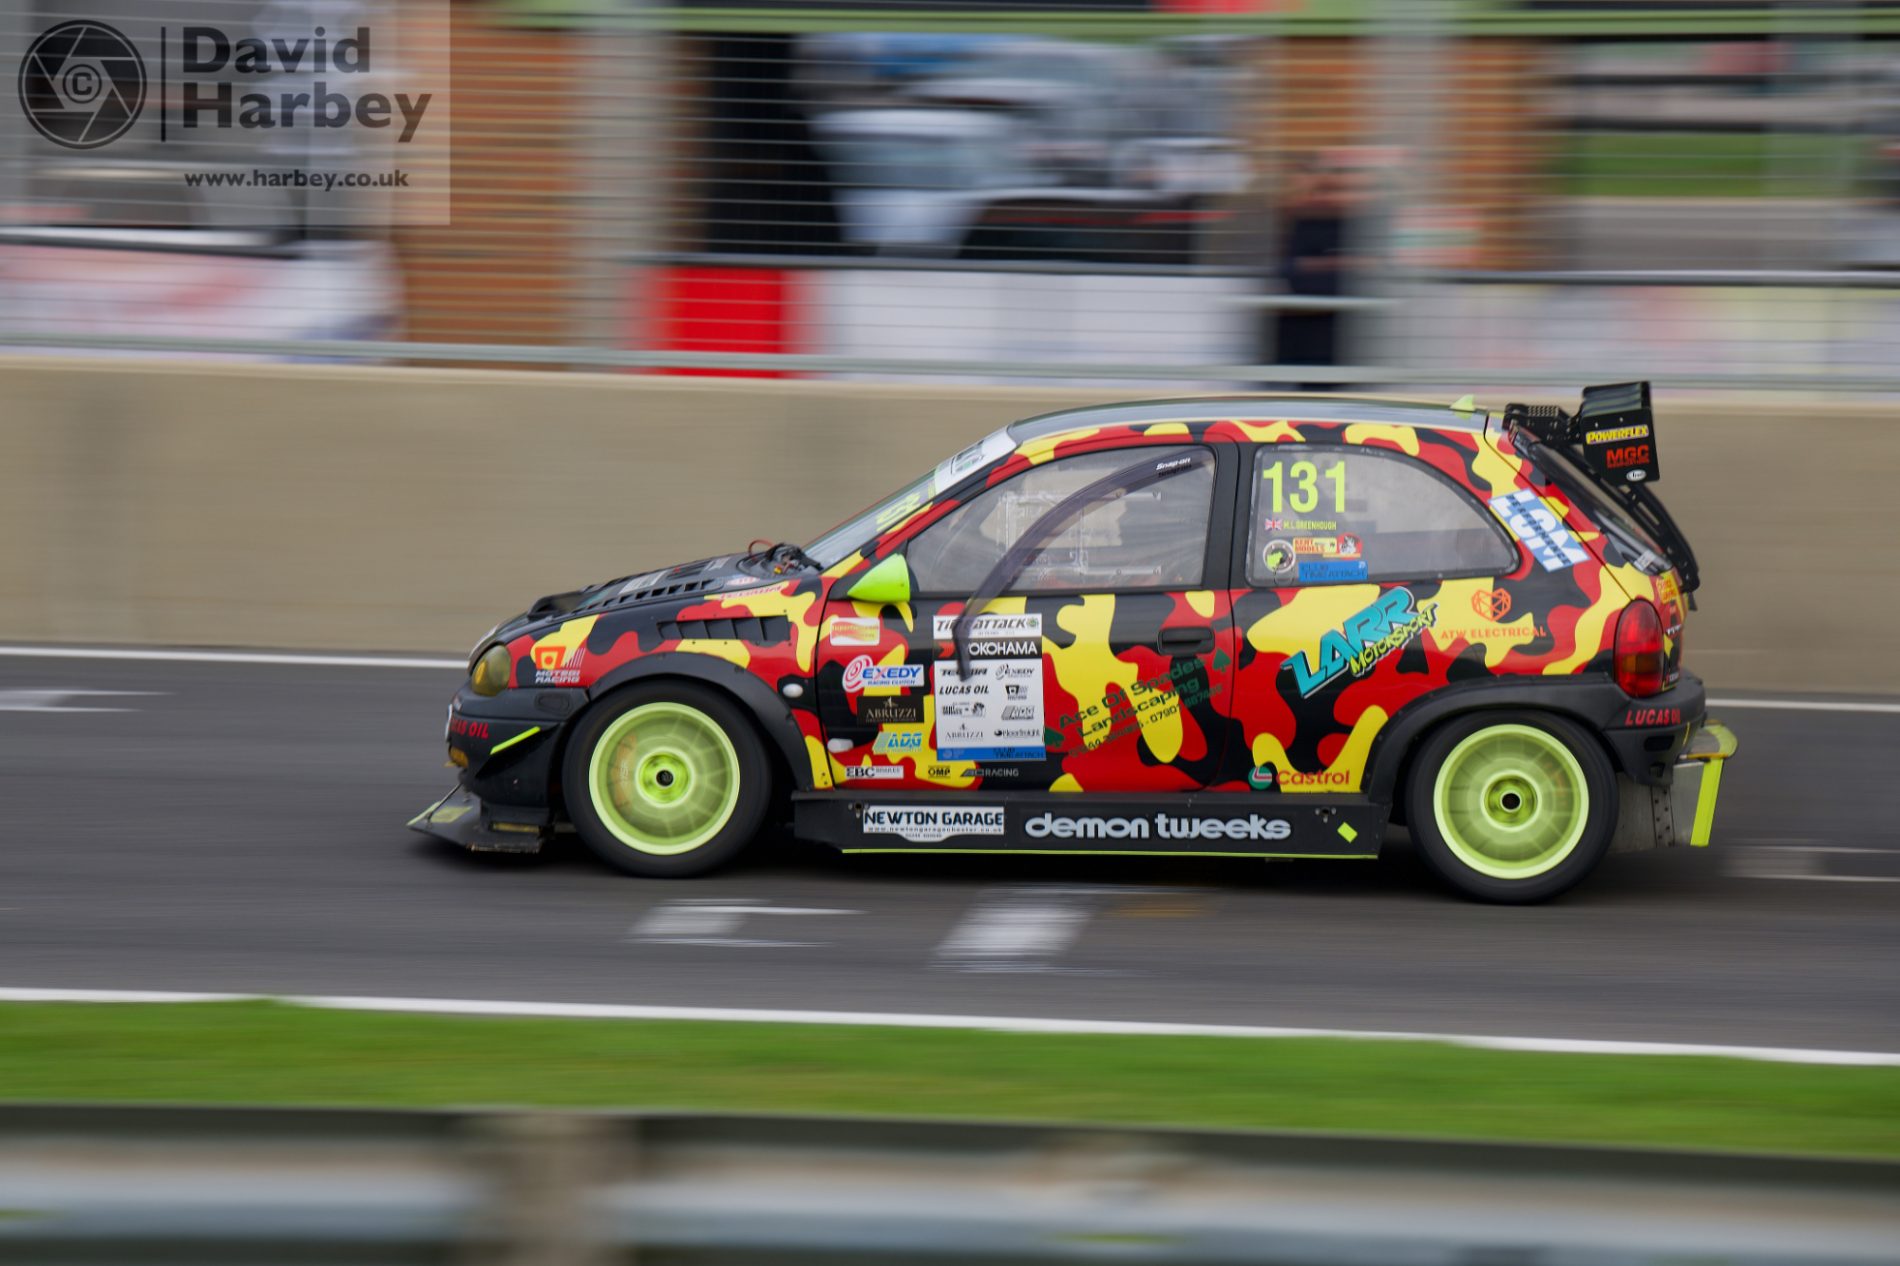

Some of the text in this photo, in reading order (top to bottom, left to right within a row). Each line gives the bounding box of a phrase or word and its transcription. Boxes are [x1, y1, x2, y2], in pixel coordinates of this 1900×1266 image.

[1586, 425, 1648, 444] POWERFLEX
[1606, 444, 1649, 464] MGC
[1263, 461, 1345, 513] 131
[1441, 626, 1547, 640] ATW ELECTRICAL
[968, 641, 1038, 656] OKOHAMA
[1280, 586, 1419, 698] LARR
[862, 667, 922, 679] EXEDY
[939, 685, 989, 695] LUCAS OIL
[1059, 705, 1099, 729] Ace
[1102, 688, 1127, 709] Of
[1131, 657, 1206, 696] Spades
[866, 708, 916, 718] ABRUZZI
[1077, 676, 1200, 737] Landscaping
[1625, 708, 1669, 726] LUCAS
[468, 721, 489, 739] OIL
[846, 767, 875, 777] EBC
[928, 767, 950, 776] OMP
[985, 767, 1019, 777] RACING
[1276, 769, 1350, 785] Castrol
[864, 811, 1004, 825] NEWTON GARAGE
[1025, 812, 1291, 839] demon tweeks
